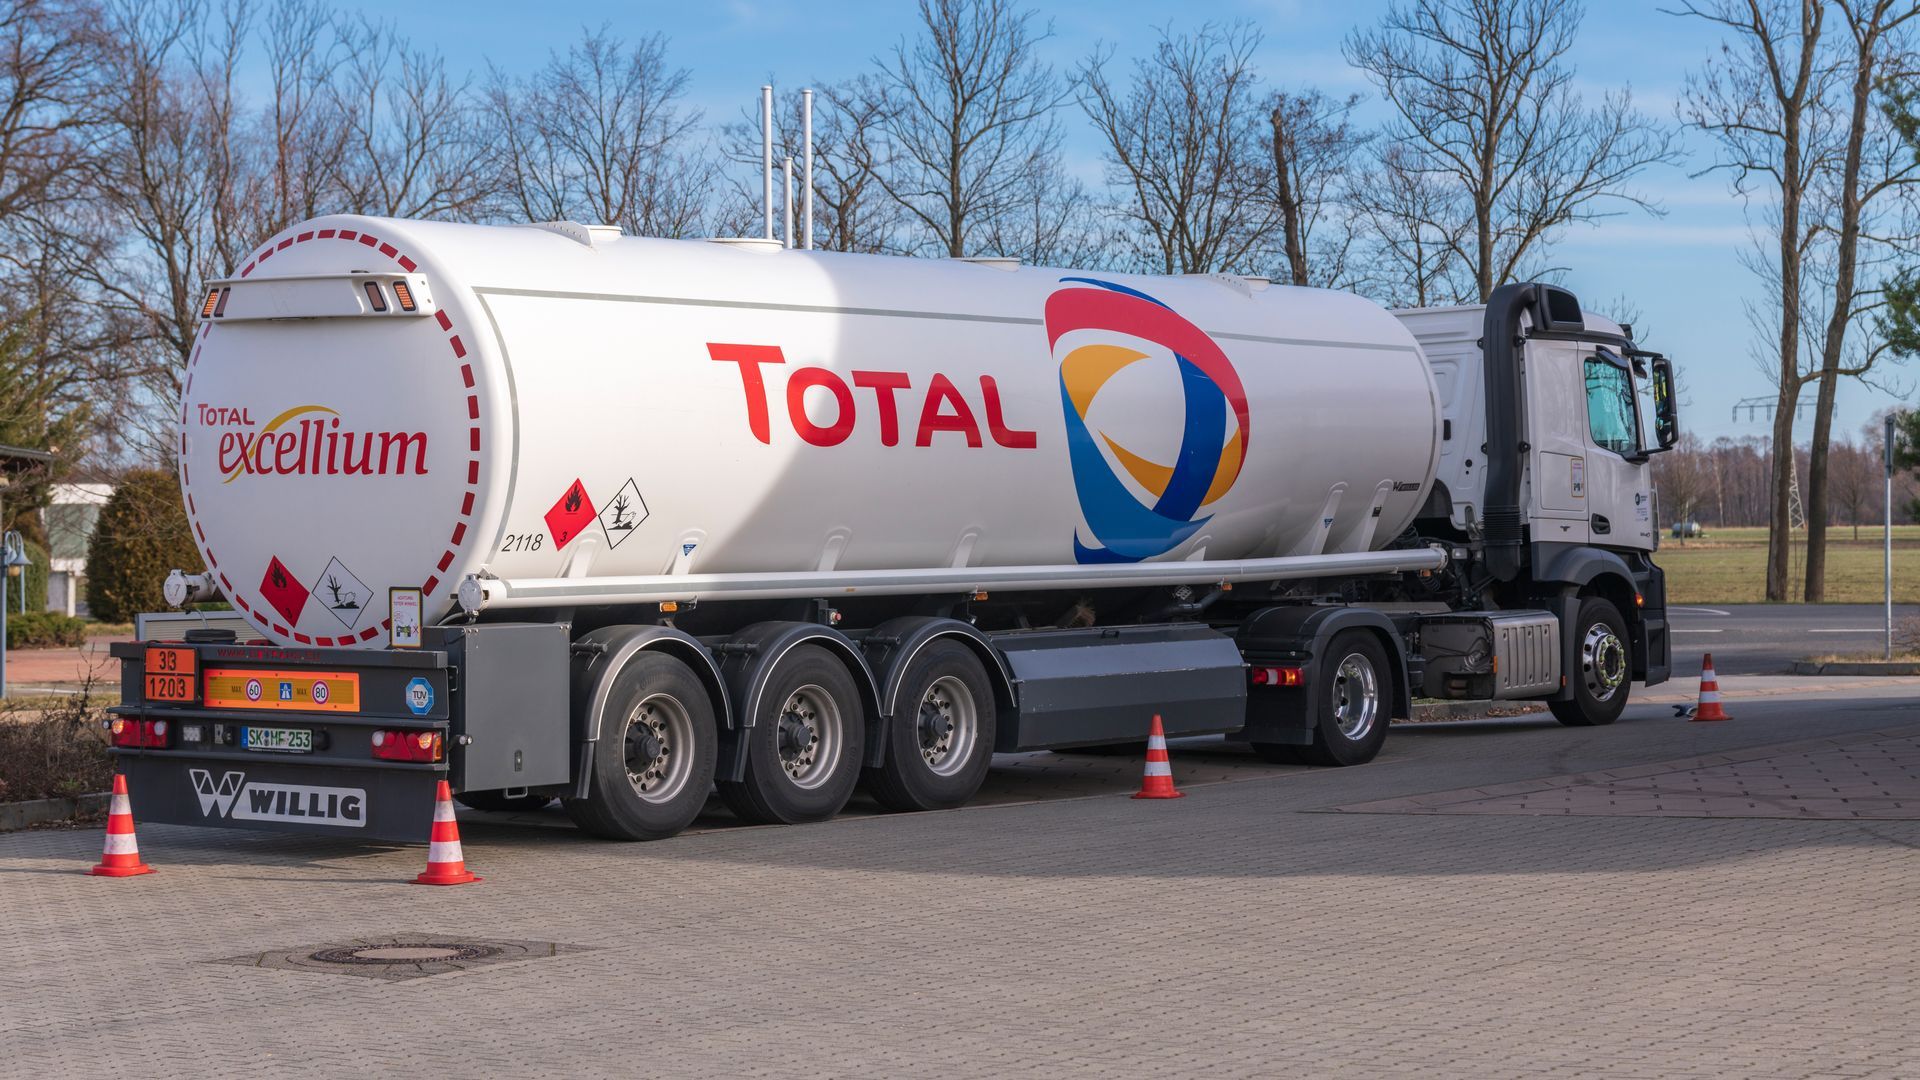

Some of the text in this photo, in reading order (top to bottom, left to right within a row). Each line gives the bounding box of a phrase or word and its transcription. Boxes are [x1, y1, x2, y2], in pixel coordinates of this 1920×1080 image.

[706, 342, 1037, 449] TOTAL
[198, 404, 255, 426] TOTAL
[218, 417, 429, 475] excellium
[501, 533, 544, 552] 2118
[560, 531, 568, 542] 3
[159, 650, 177, 671] 33
[150, 677, 186, 698] 1203
[249, 684, 259, 696] 60
[315, 687, 326, 698] 80
[249, 729, 263, 746] SK
[288, 731, 311, 748] 253
[249, 789, 361, 820] WILLIG
